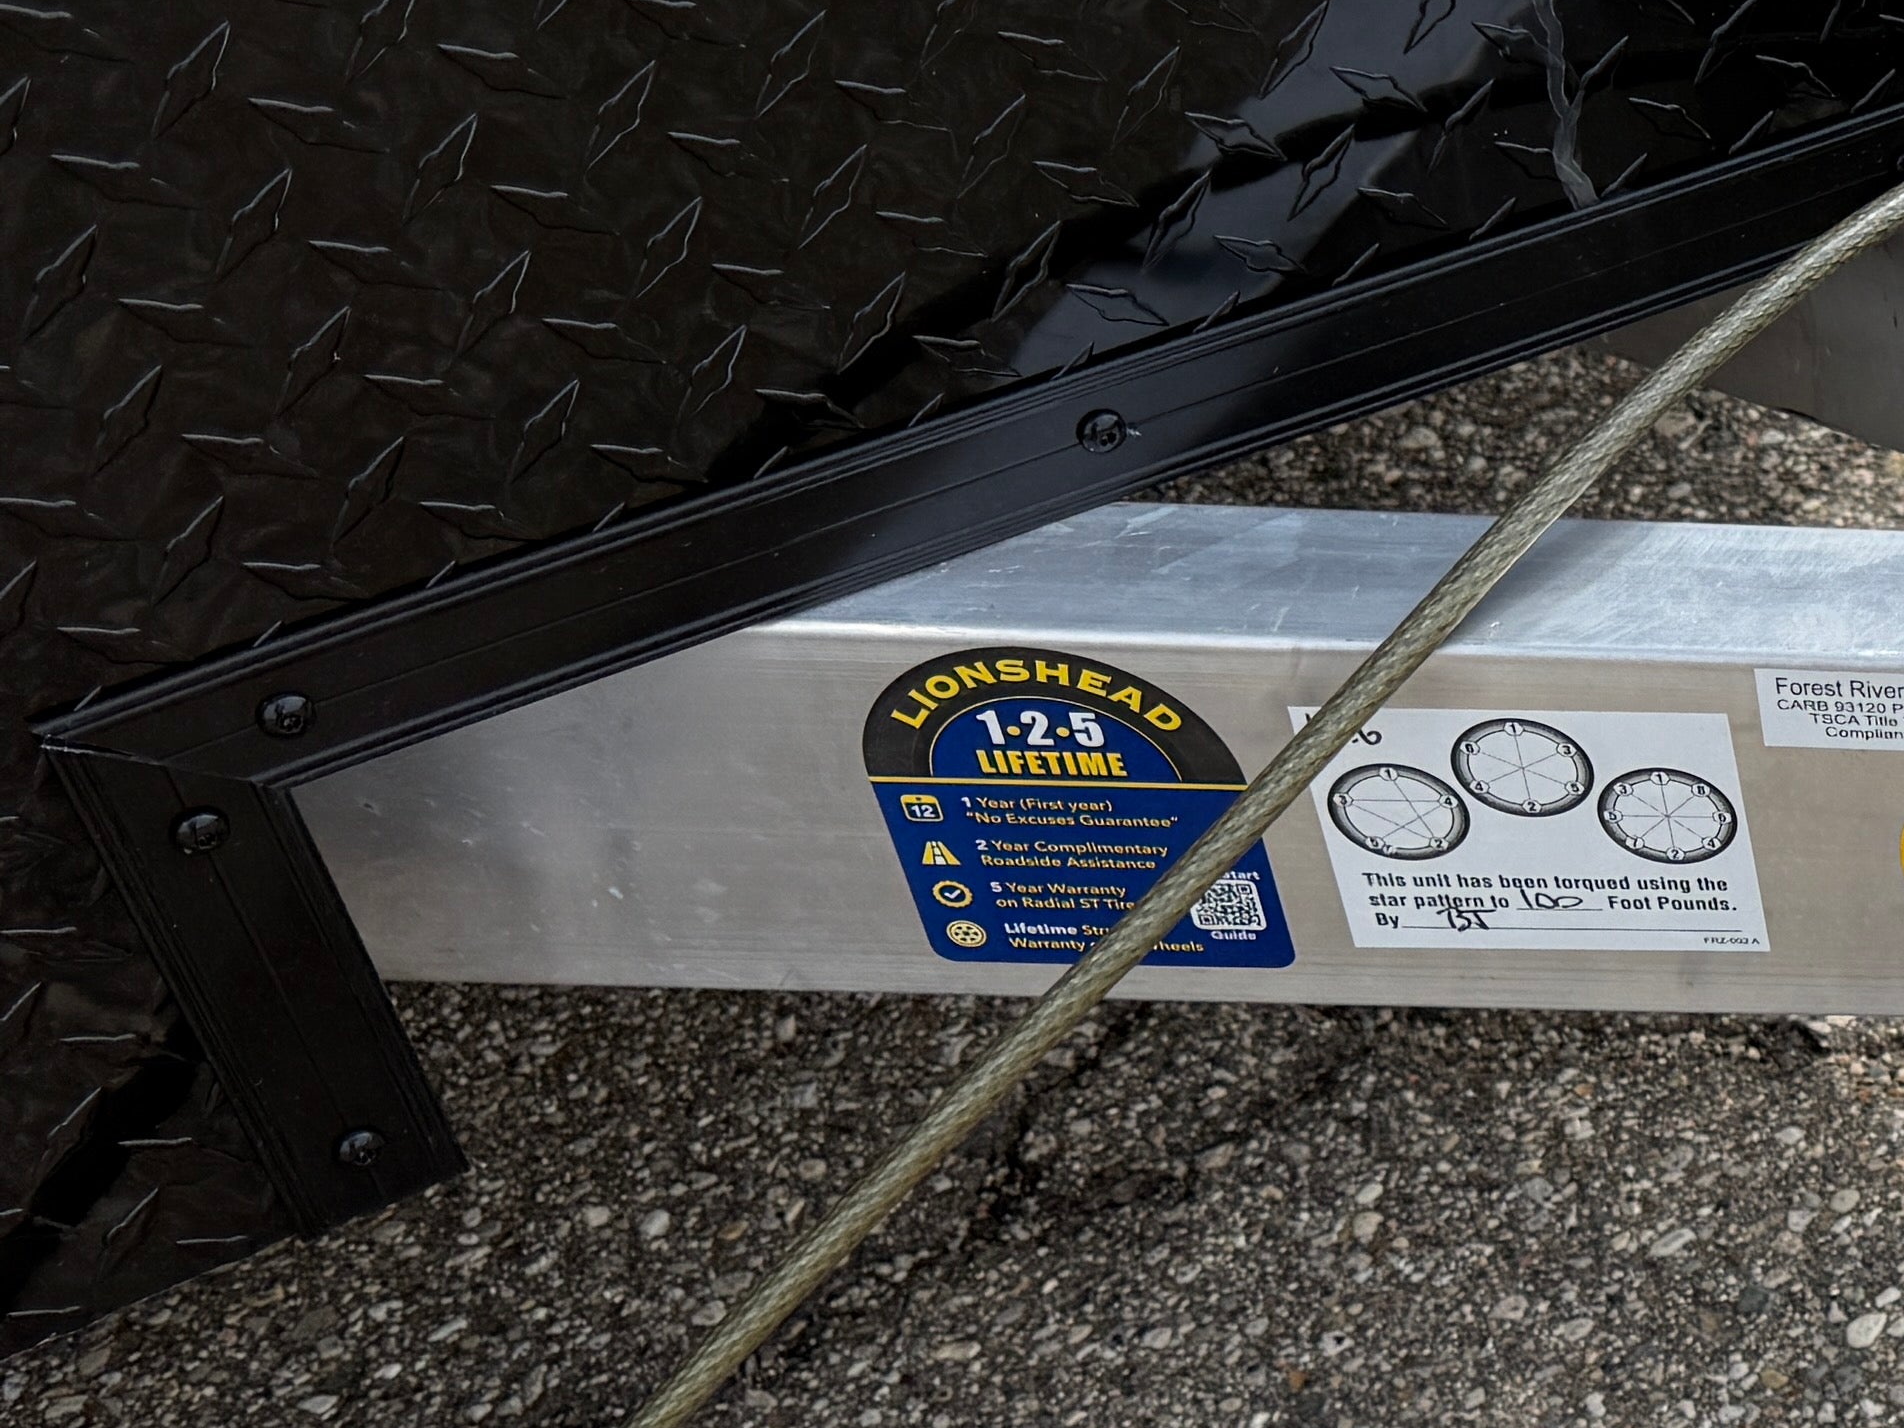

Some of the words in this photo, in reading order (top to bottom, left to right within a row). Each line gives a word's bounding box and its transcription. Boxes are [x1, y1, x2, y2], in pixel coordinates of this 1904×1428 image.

[890, 659, 1182, 730] LIONSHEAD
[1775, 677, 1843, 698] Forest
[1777, 699, 1828, 712] CARB
[1835, 701, 1886, 714] 93120
[1809, 713, 1861, 726] TSCA
[1865, 715, 1898, 727] Title
[976, 750, 1128, 777] LIFETIME
[911, 803, 936, 818] 12
[961, 797, 971, 808] 1
[976, 797, 1015, 810] Year
[1020, 798, 1064, 812] (First
[1068, 800, 1113, 813] year)
[1006, 813, 1075, 827] Excuses
[975, 840, 989, 851] 2
[991, 840, 1030, 853] Year
[1034, 841, 1168, 857] Complimentary
[981, 855, 1062, 868] Roadside
[1066, 856, 1156, 870] Assistance
[990, 882, 1002, 894] 5
[1005, 882, 1044, 894] Year
[1050, 883, 1126, 897] Warranty
[1362, 872, 1406, 888] This
[1413, 873, 1451, 888] unit
[1457, 874, 1493, 888] has
[1499, 875, 1548, 889] been
[1554, 876, 1630, 892] torqued
[1637, 876, 1691, 893] using
[1697, 877, 1728, 891] the
[996, 899, 1018, 908] on
[1023, 898, 1076, 910] Radial
[1080, 899, 1099, 910] ST
[1369, 894, 1406, 907] star
[1414, 894, 1484, 909] pattern
[1491, 895, 1509, 908] to
[1607, 896, 1652, 910] Foot
[1657, 896, 1737, 911] Pounds.
[1375, 913, 1399, 929] By
[1004, 922, 1077, 936] Lifetime
[1211, 931, 1257, 941] Guide
[1009, 937, 1085, 952] Warranty
[1153, 941, 1204, 953] heels
